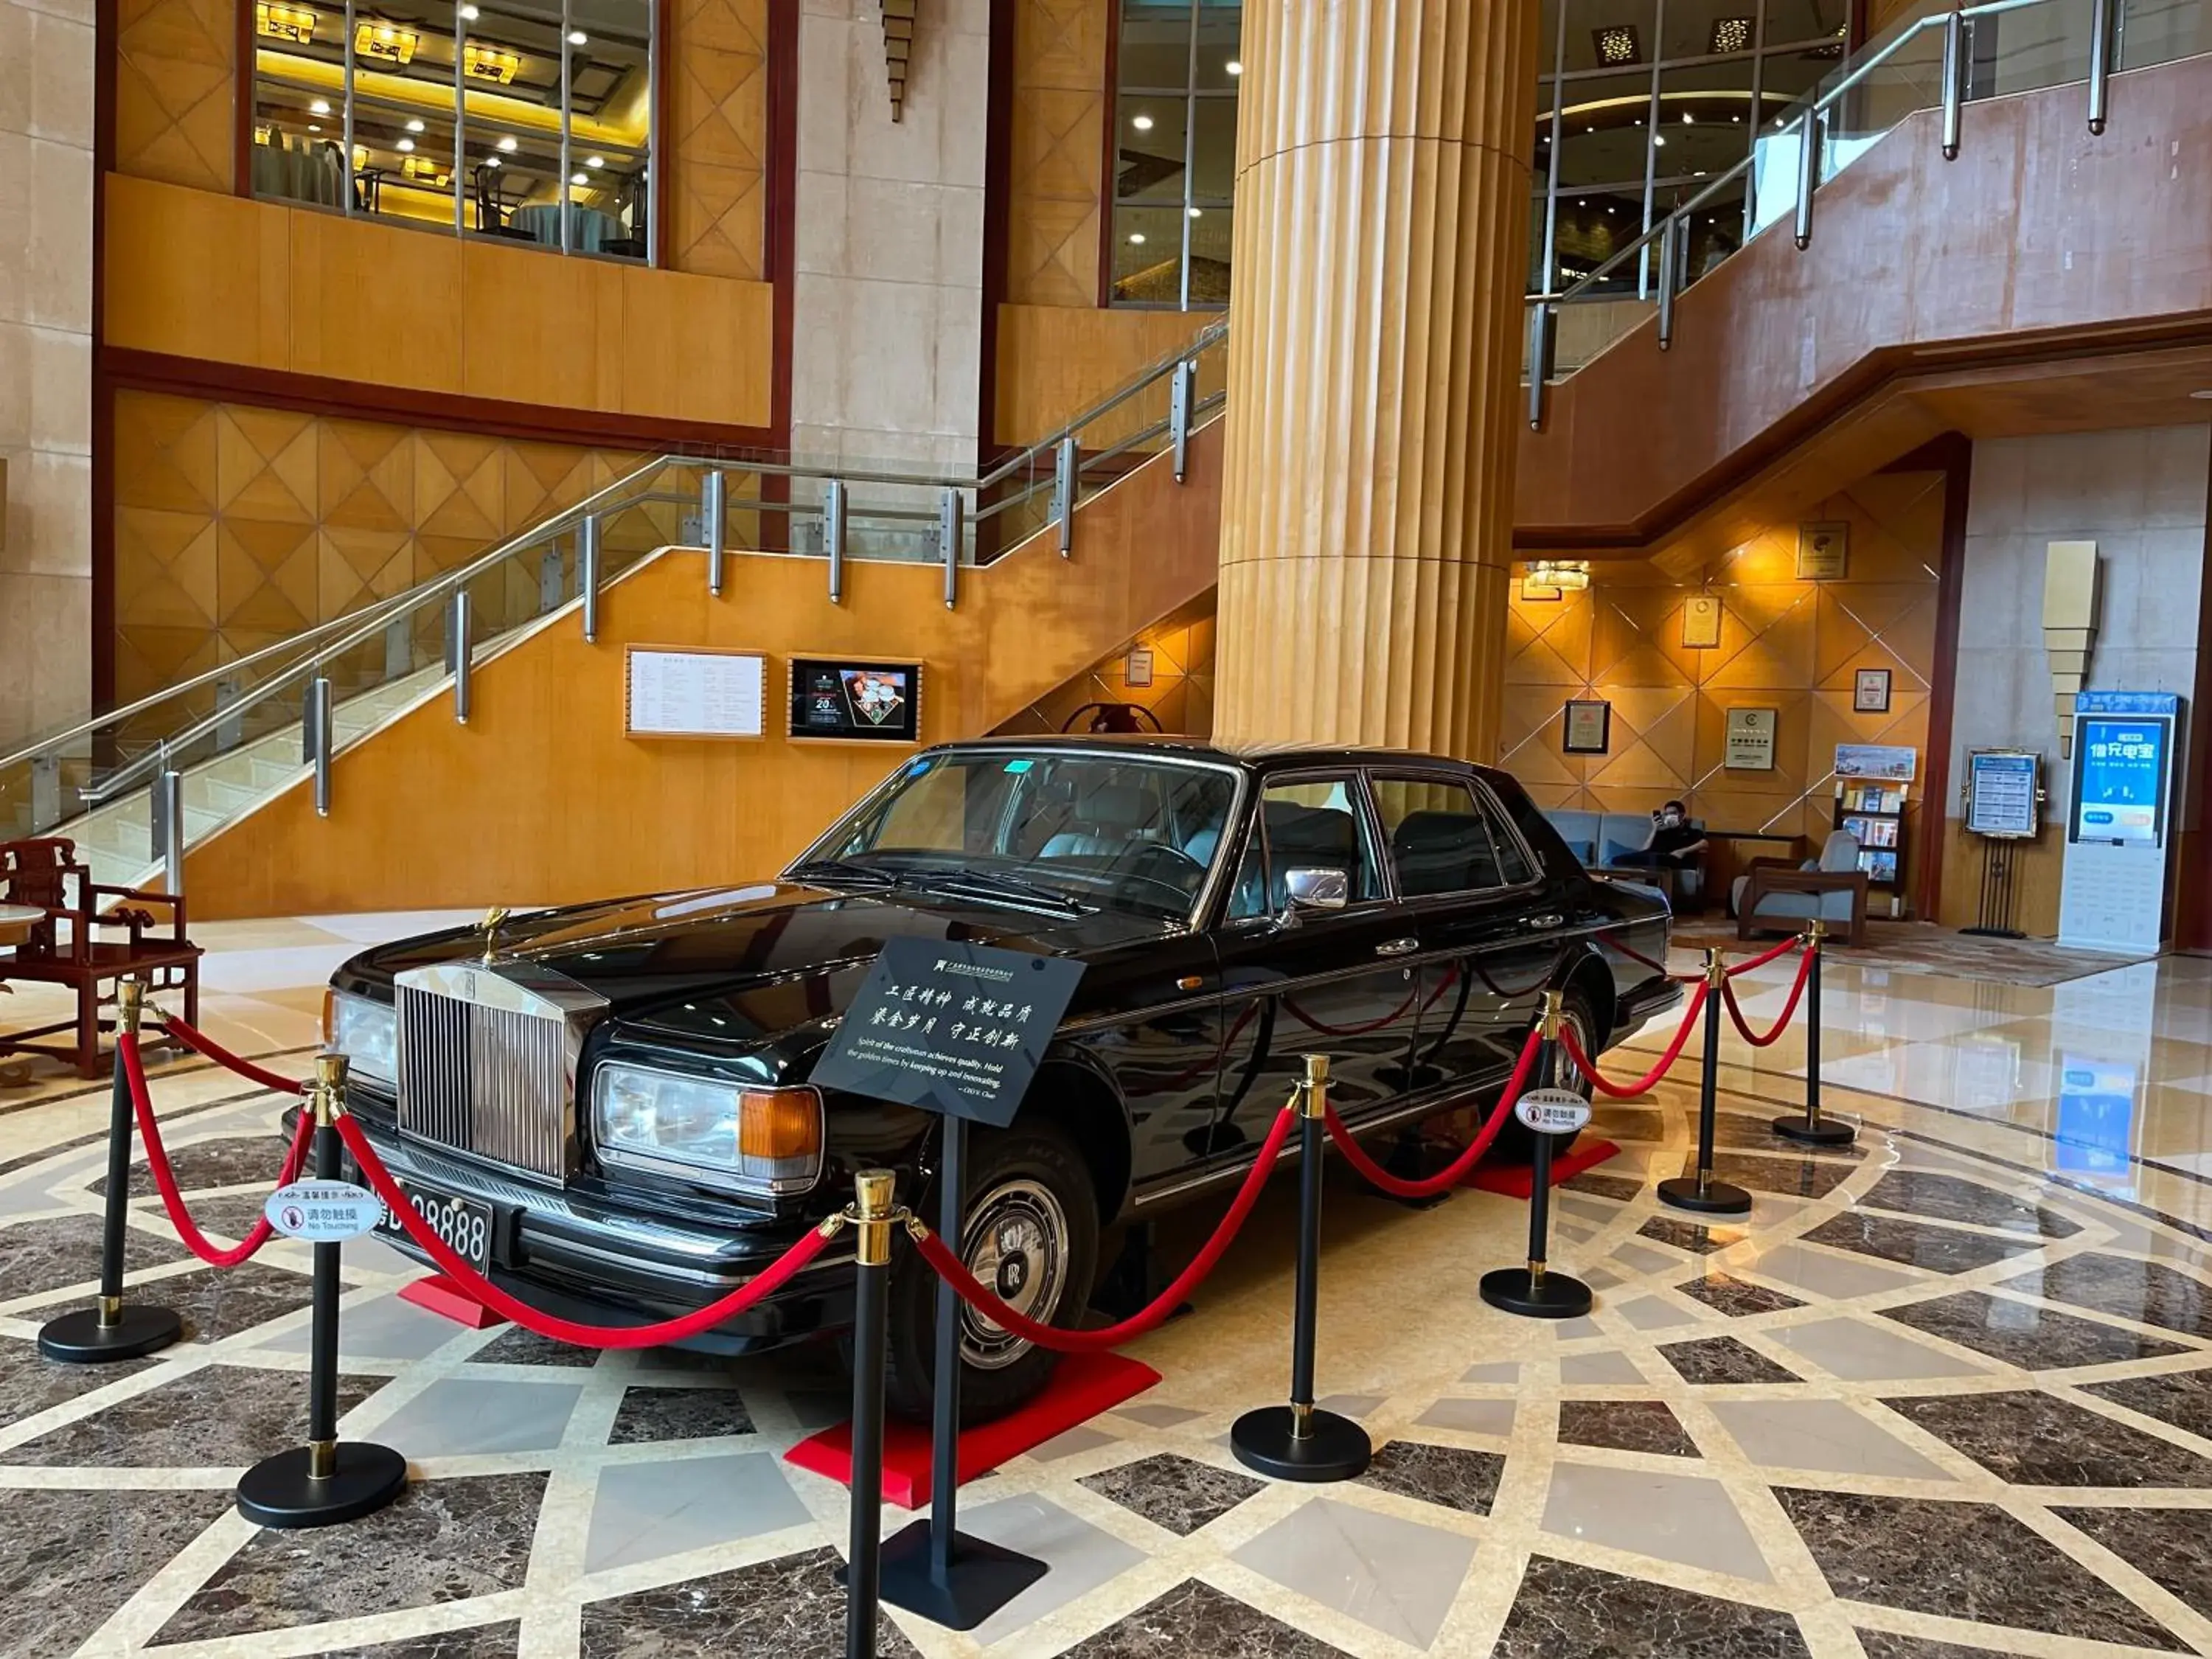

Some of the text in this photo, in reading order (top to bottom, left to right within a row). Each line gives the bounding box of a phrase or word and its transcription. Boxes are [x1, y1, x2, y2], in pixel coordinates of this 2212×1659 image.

[2090, 742, 2155, 759] 借充电宝
[885, 985, 1032, 1023] 工匠精神 成就品质
[950, 1021, 1019, 1050] 守正创新
[883, 1040, 894, 1050] the
[983, 1062, 1004, 1074] Hold
[900, 1058, 910, 1069] by
[909, 1060, 937, 1076] keeping
[937, 1068, 947, 1077] up
[947, 1071, 964, 1079] and
[307, 1208, 358, 1220] 请勿触摸
[322, 1222, 358, 1231] Touching
